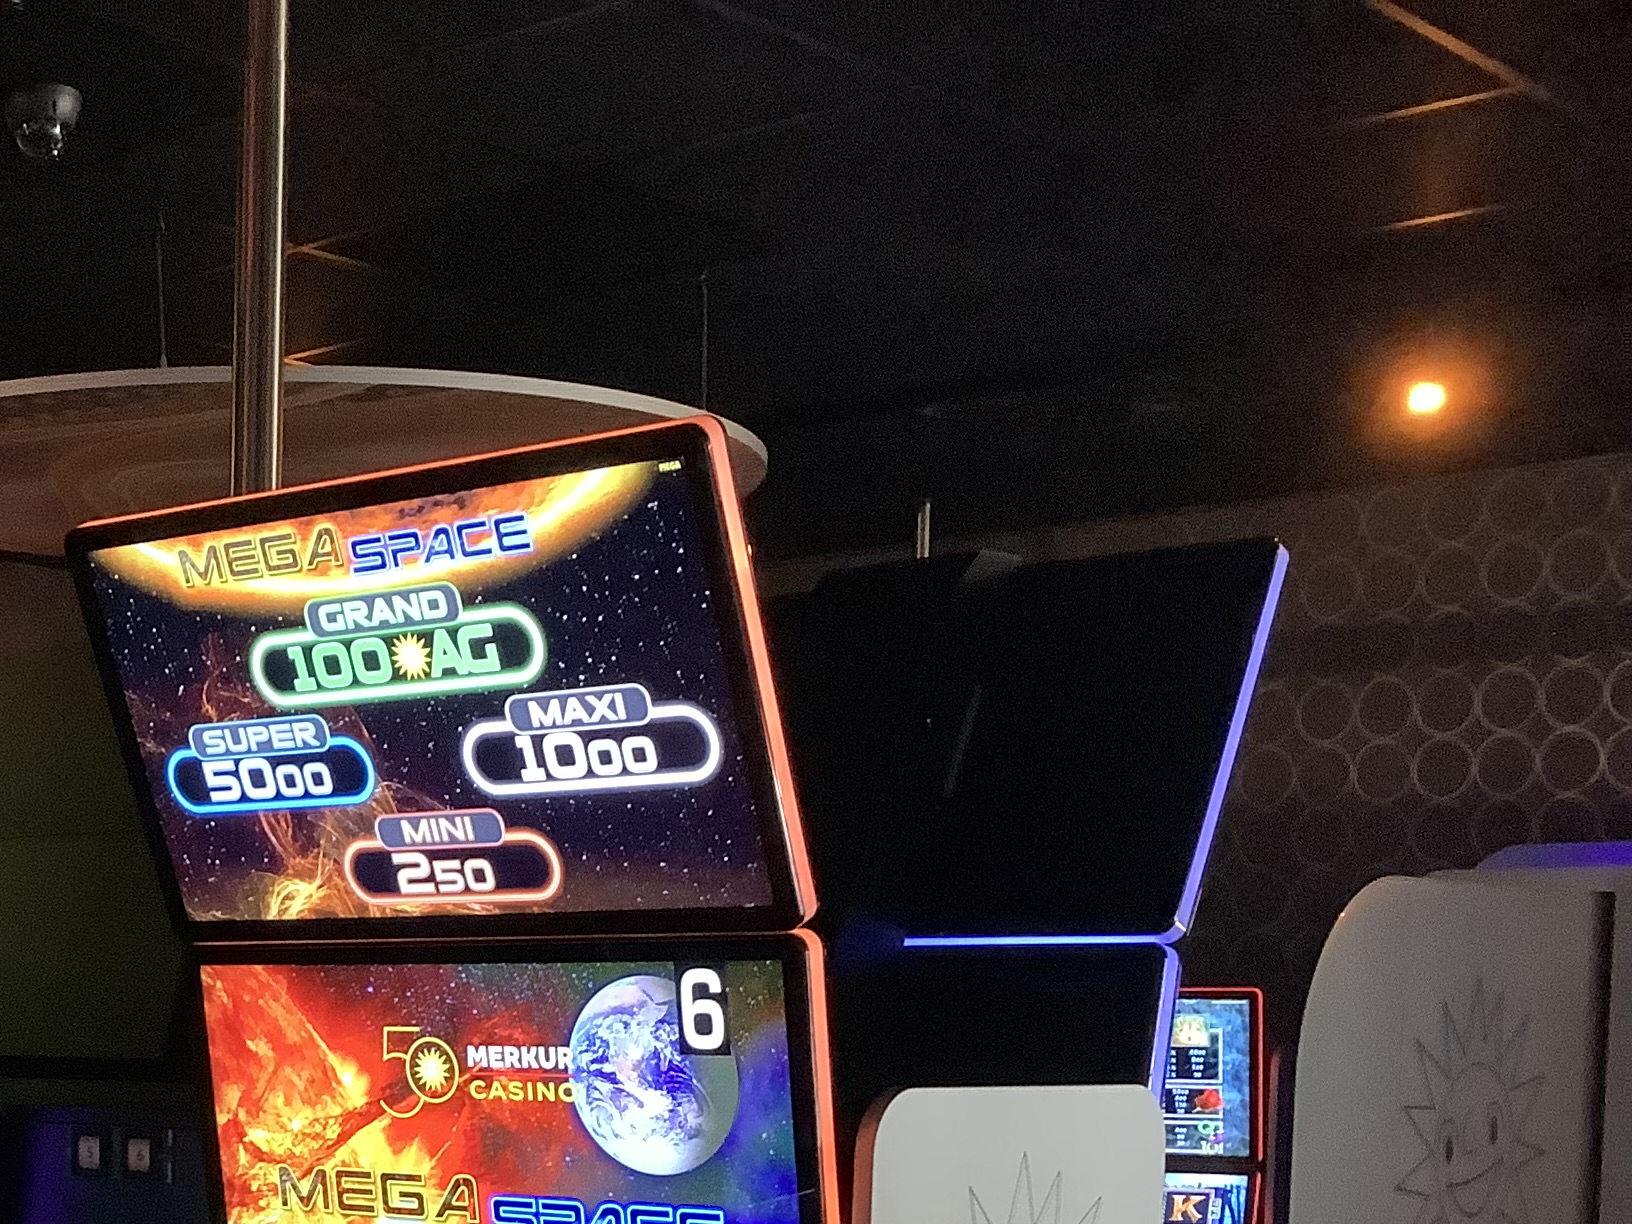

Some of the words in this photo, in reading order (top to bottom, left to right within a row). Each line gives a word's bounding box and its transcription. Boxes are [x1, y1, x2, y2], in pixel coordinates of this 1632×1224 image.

[177, 526, 343, 588] MEGA
[349, 514, 534, 576] SPACE
[319, 593, 448, 631] GRAND
[527, 692, 628, 729] MAXI
[200, 722, 319, 754] SUPER
[515, 732, 659, 783] 1000
[202, 757, 333, 803] 5000
[401, 818, 475, 845] MINI
[393, 853, 494, 895] 250
[680, 968, 725, 1050] 6
[467, 1045, 575, 1071] MERKUR
[469, 1079, 578, 1104] CASINO
[277, 1165, 480, 1224] MEGA
